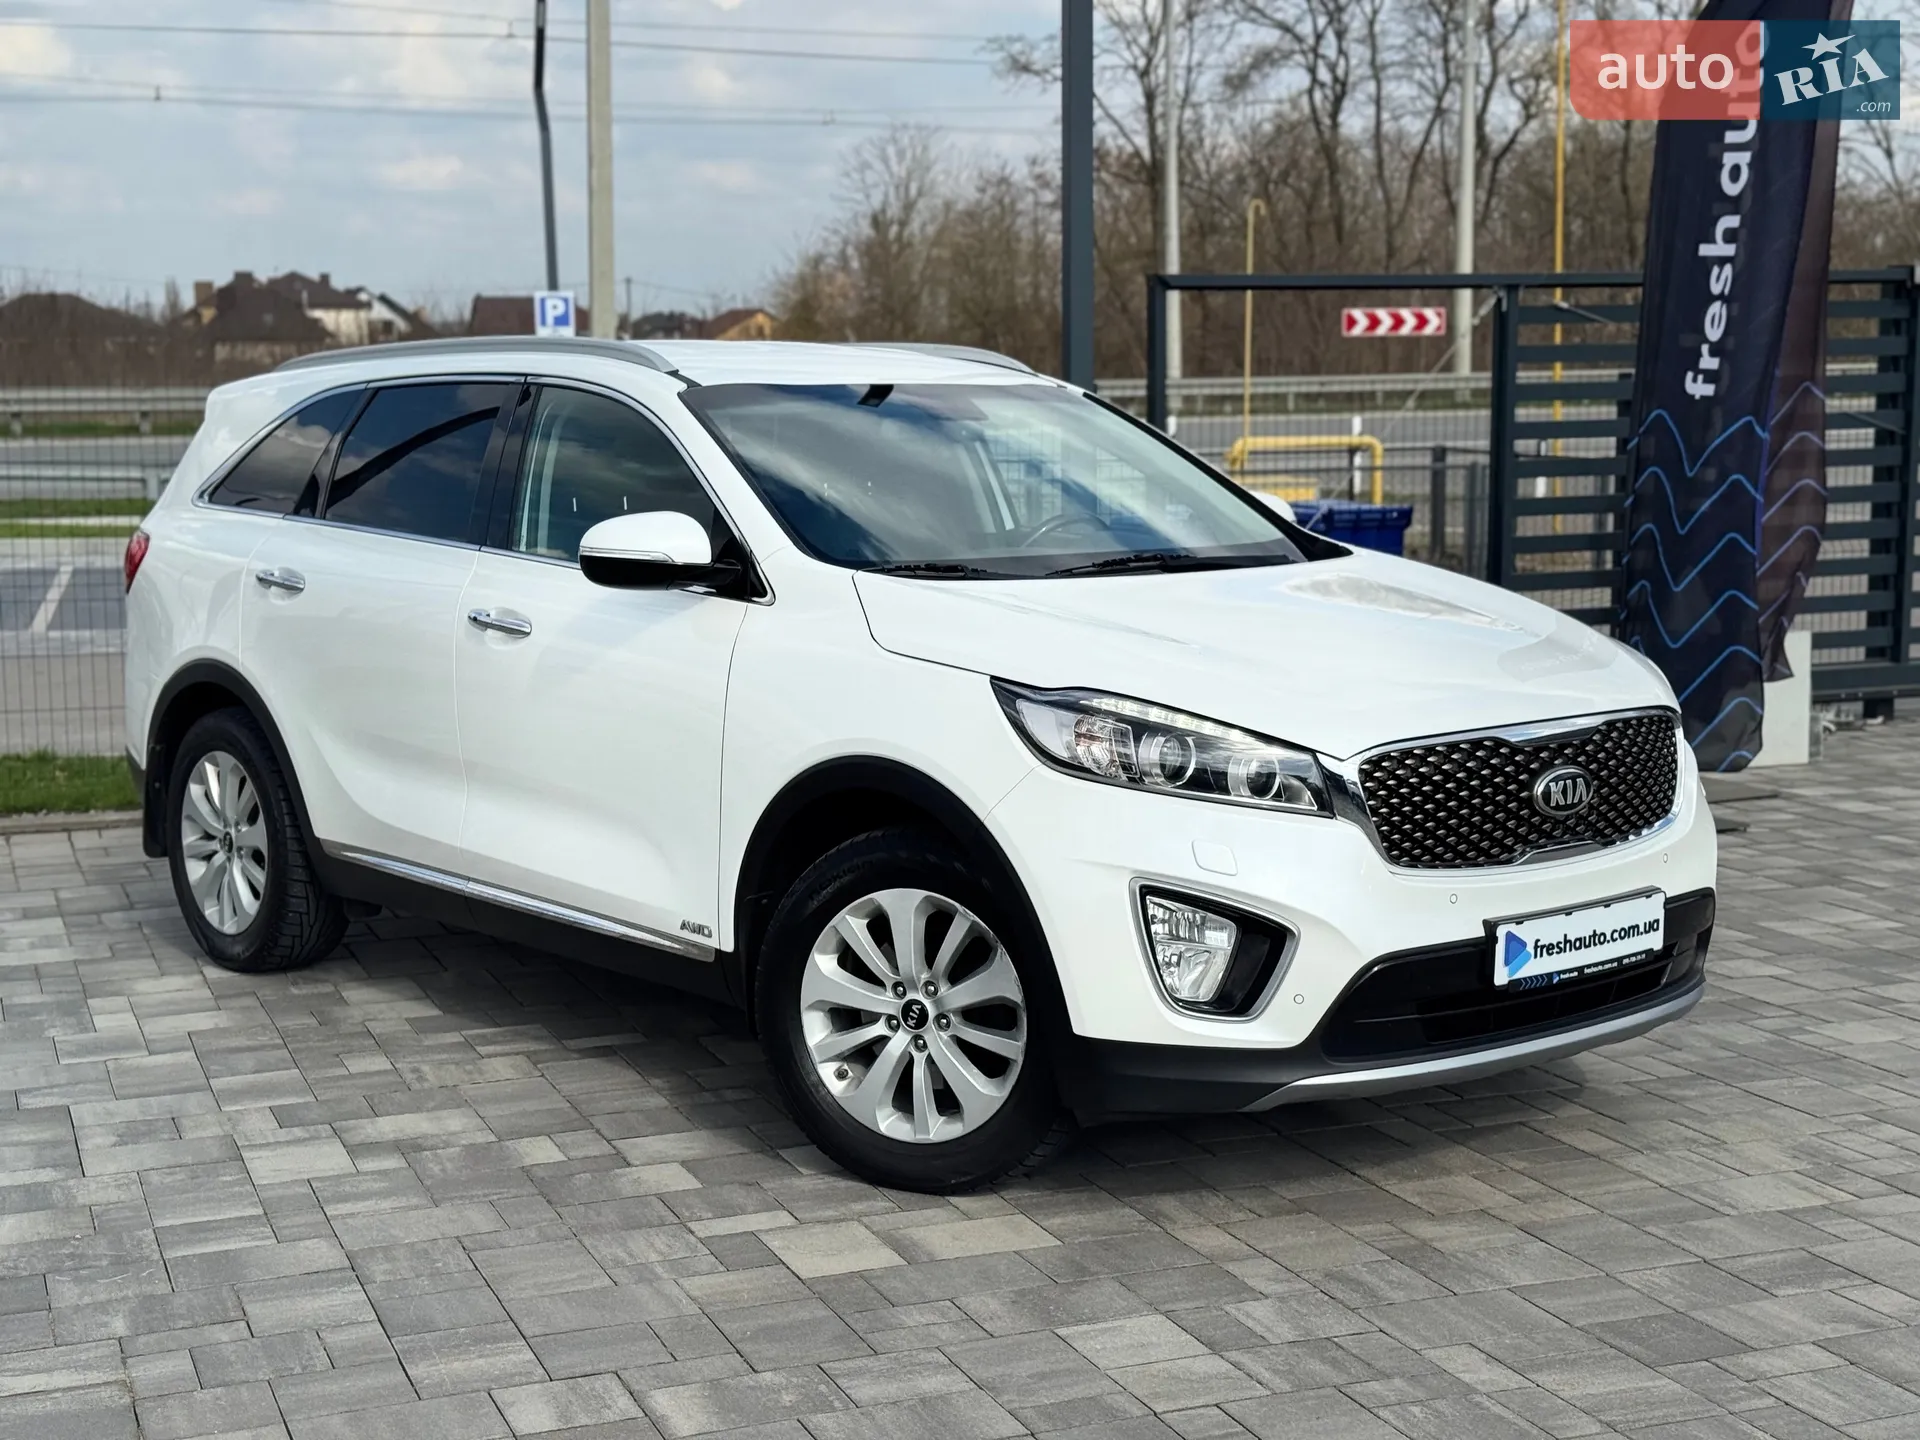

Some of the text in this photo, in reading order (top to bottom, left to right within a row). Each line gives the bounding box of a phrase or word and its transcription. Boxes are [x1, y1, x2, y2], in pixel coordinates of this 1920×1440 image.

[544, 298, 567, 328] P
[1684, 214, 1742, 400] fresh
[1548, 777, 1588, 807] KIA
[679, 919, 713, 939] AWD
[1533, 917, 1661, 960] freshauto.com.ua
[906, 1004, 922, 1028] KIA
